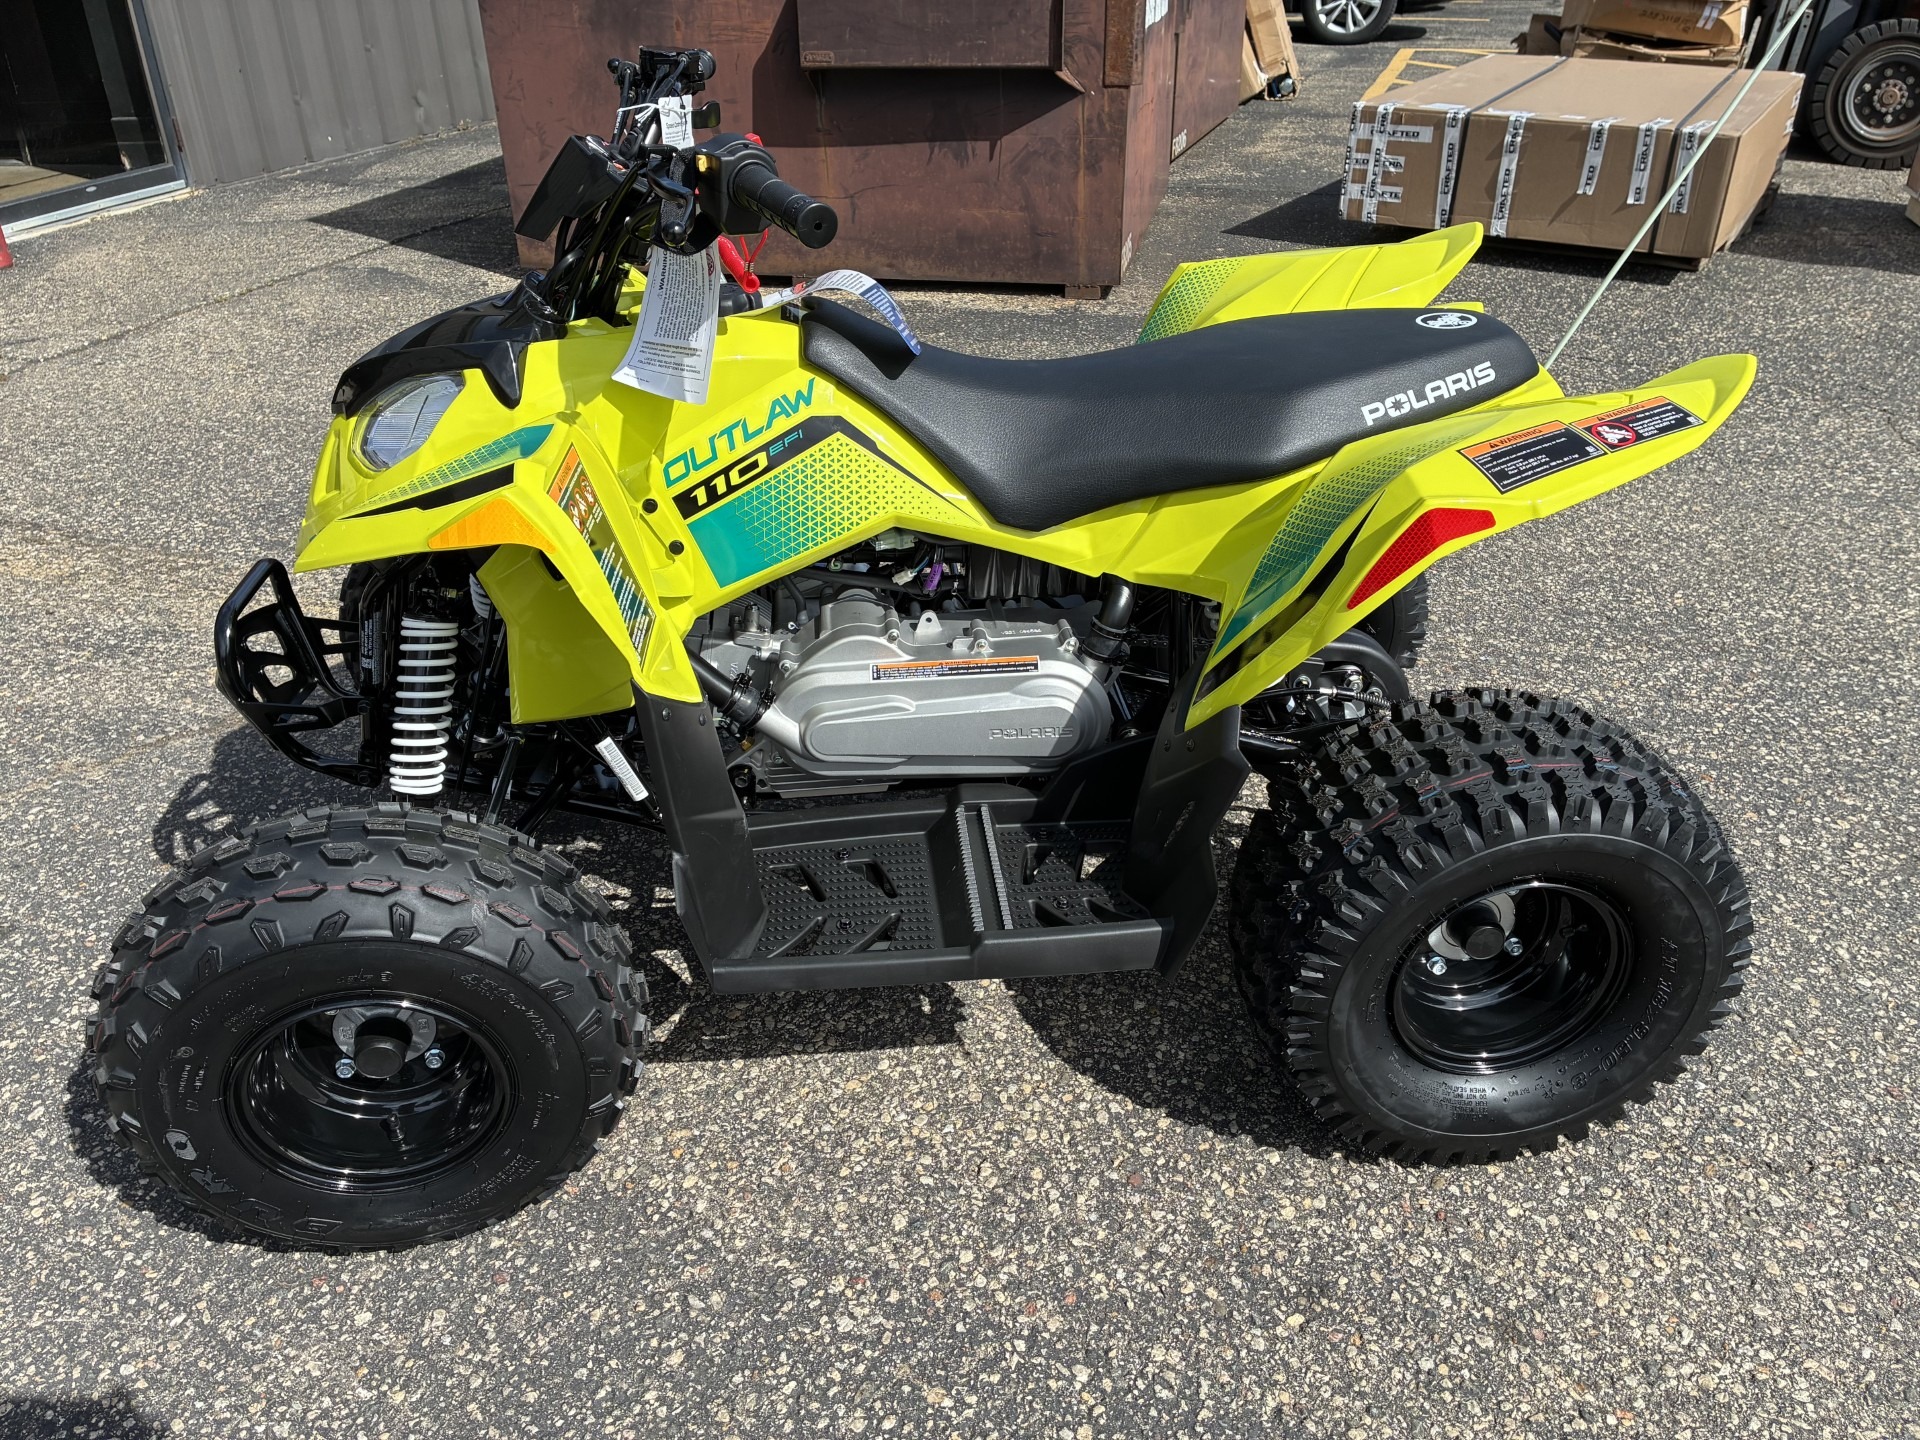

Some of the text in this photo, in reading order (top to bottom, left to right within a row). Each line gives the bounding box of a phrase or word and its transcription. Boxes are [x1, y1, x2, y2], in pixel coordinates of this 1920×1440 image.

[1369, 147, 1382, 199] CRAFTED
[1443, 142, 1455, 195] CRAFTED
[1497, 168, 1512, 220] CRAFTED
[1361, 361, 1496, 426] POLARIS
[662, 377, 816, 490] OUTLAW
[1497, 429, 1543, 445] WARNING
[689, 429, 804, 507] 110 EFI
[989, 726, 1074, 740] POLARIS
[1469, 1086, 1487, 1094] WHEN
[1508, 1086, 1531, 1098] RATING
